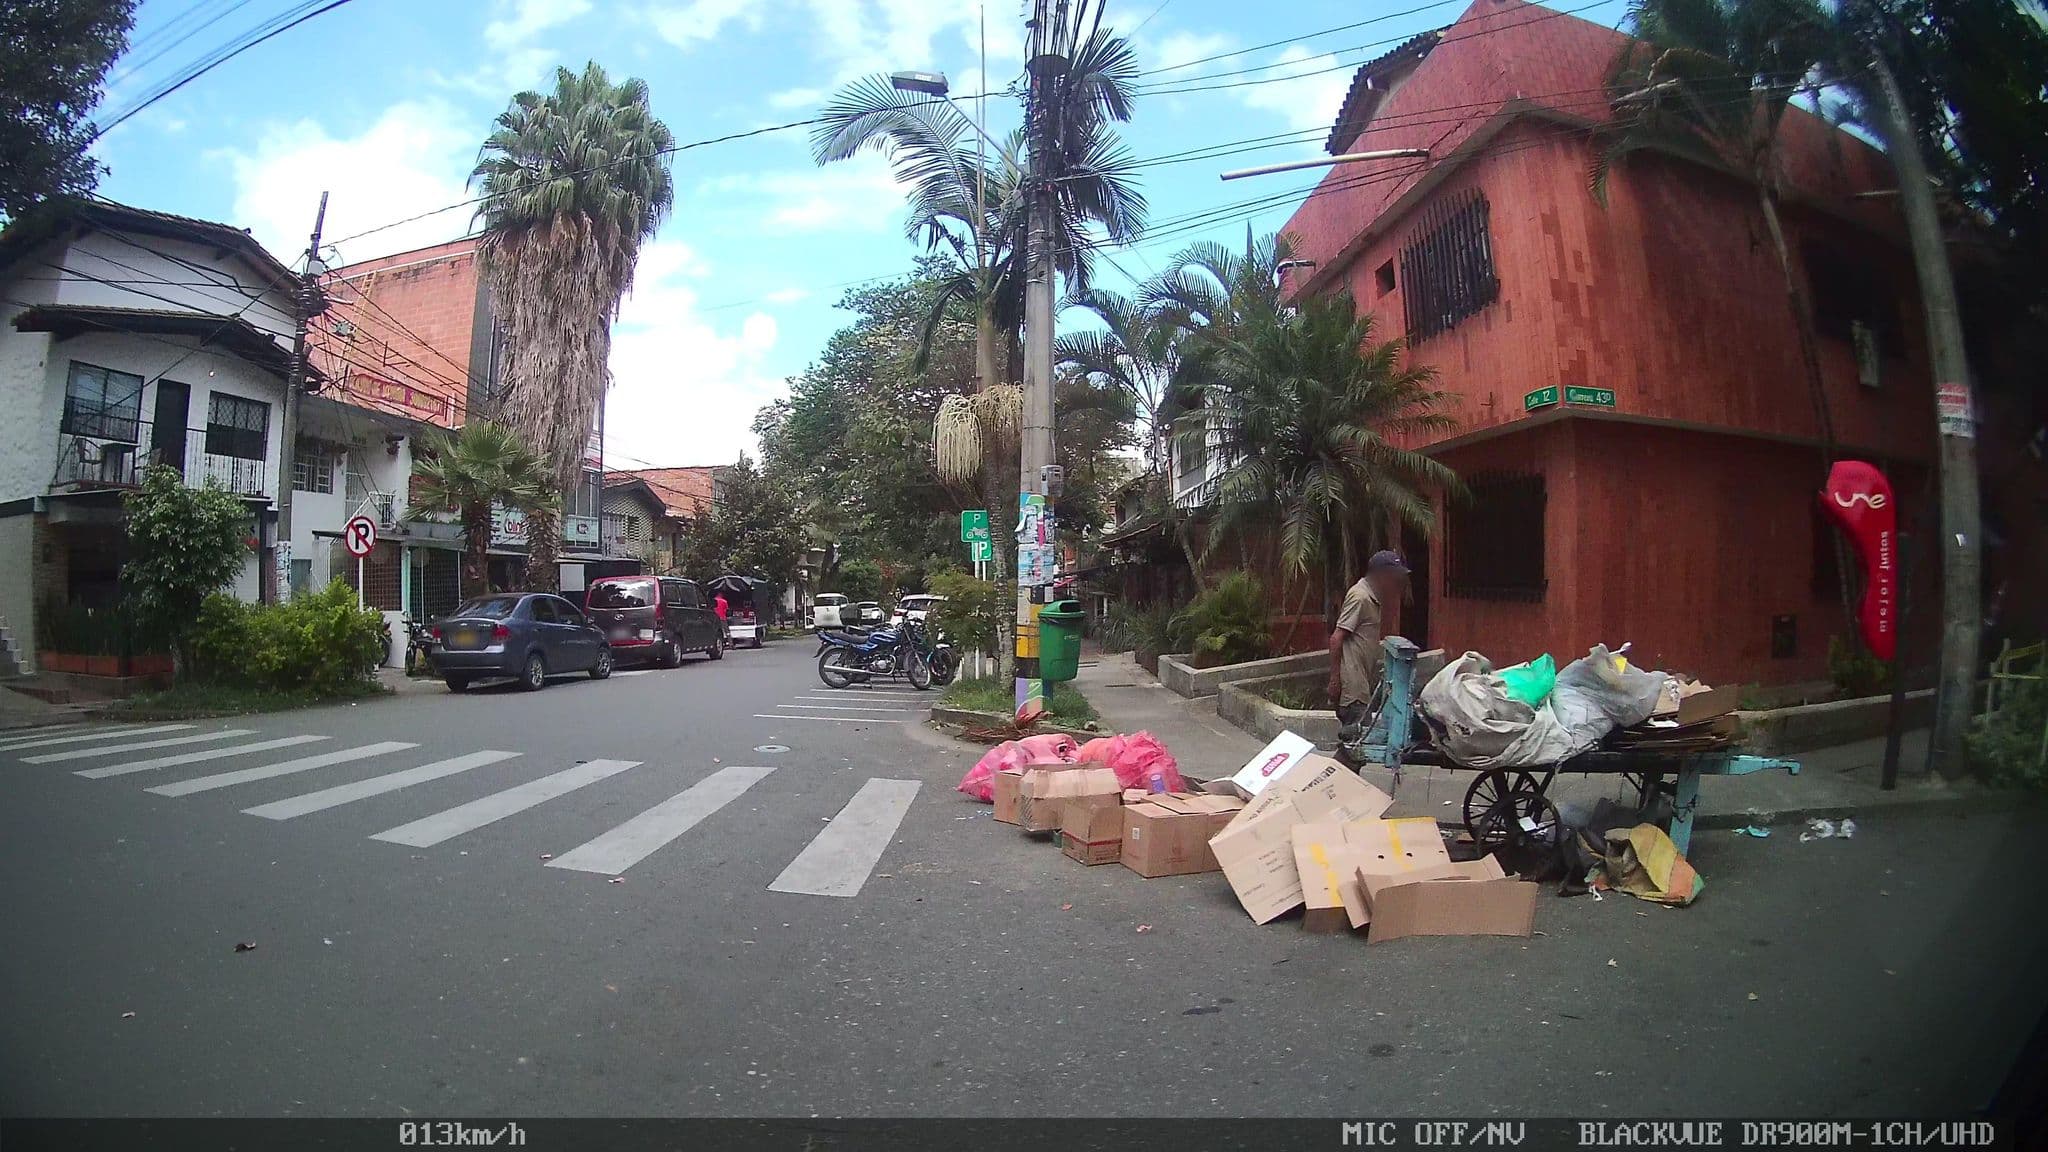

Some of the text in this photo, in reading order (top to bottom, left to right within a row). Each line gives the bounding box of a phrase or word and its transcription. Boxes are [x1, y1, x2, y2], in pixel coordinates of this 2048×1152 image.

[1542, 390, 1550, 402] 12
[973, 513, 981, 524] P
[355, 523, 370, 550] P
[979, 541, 988, 558] P
